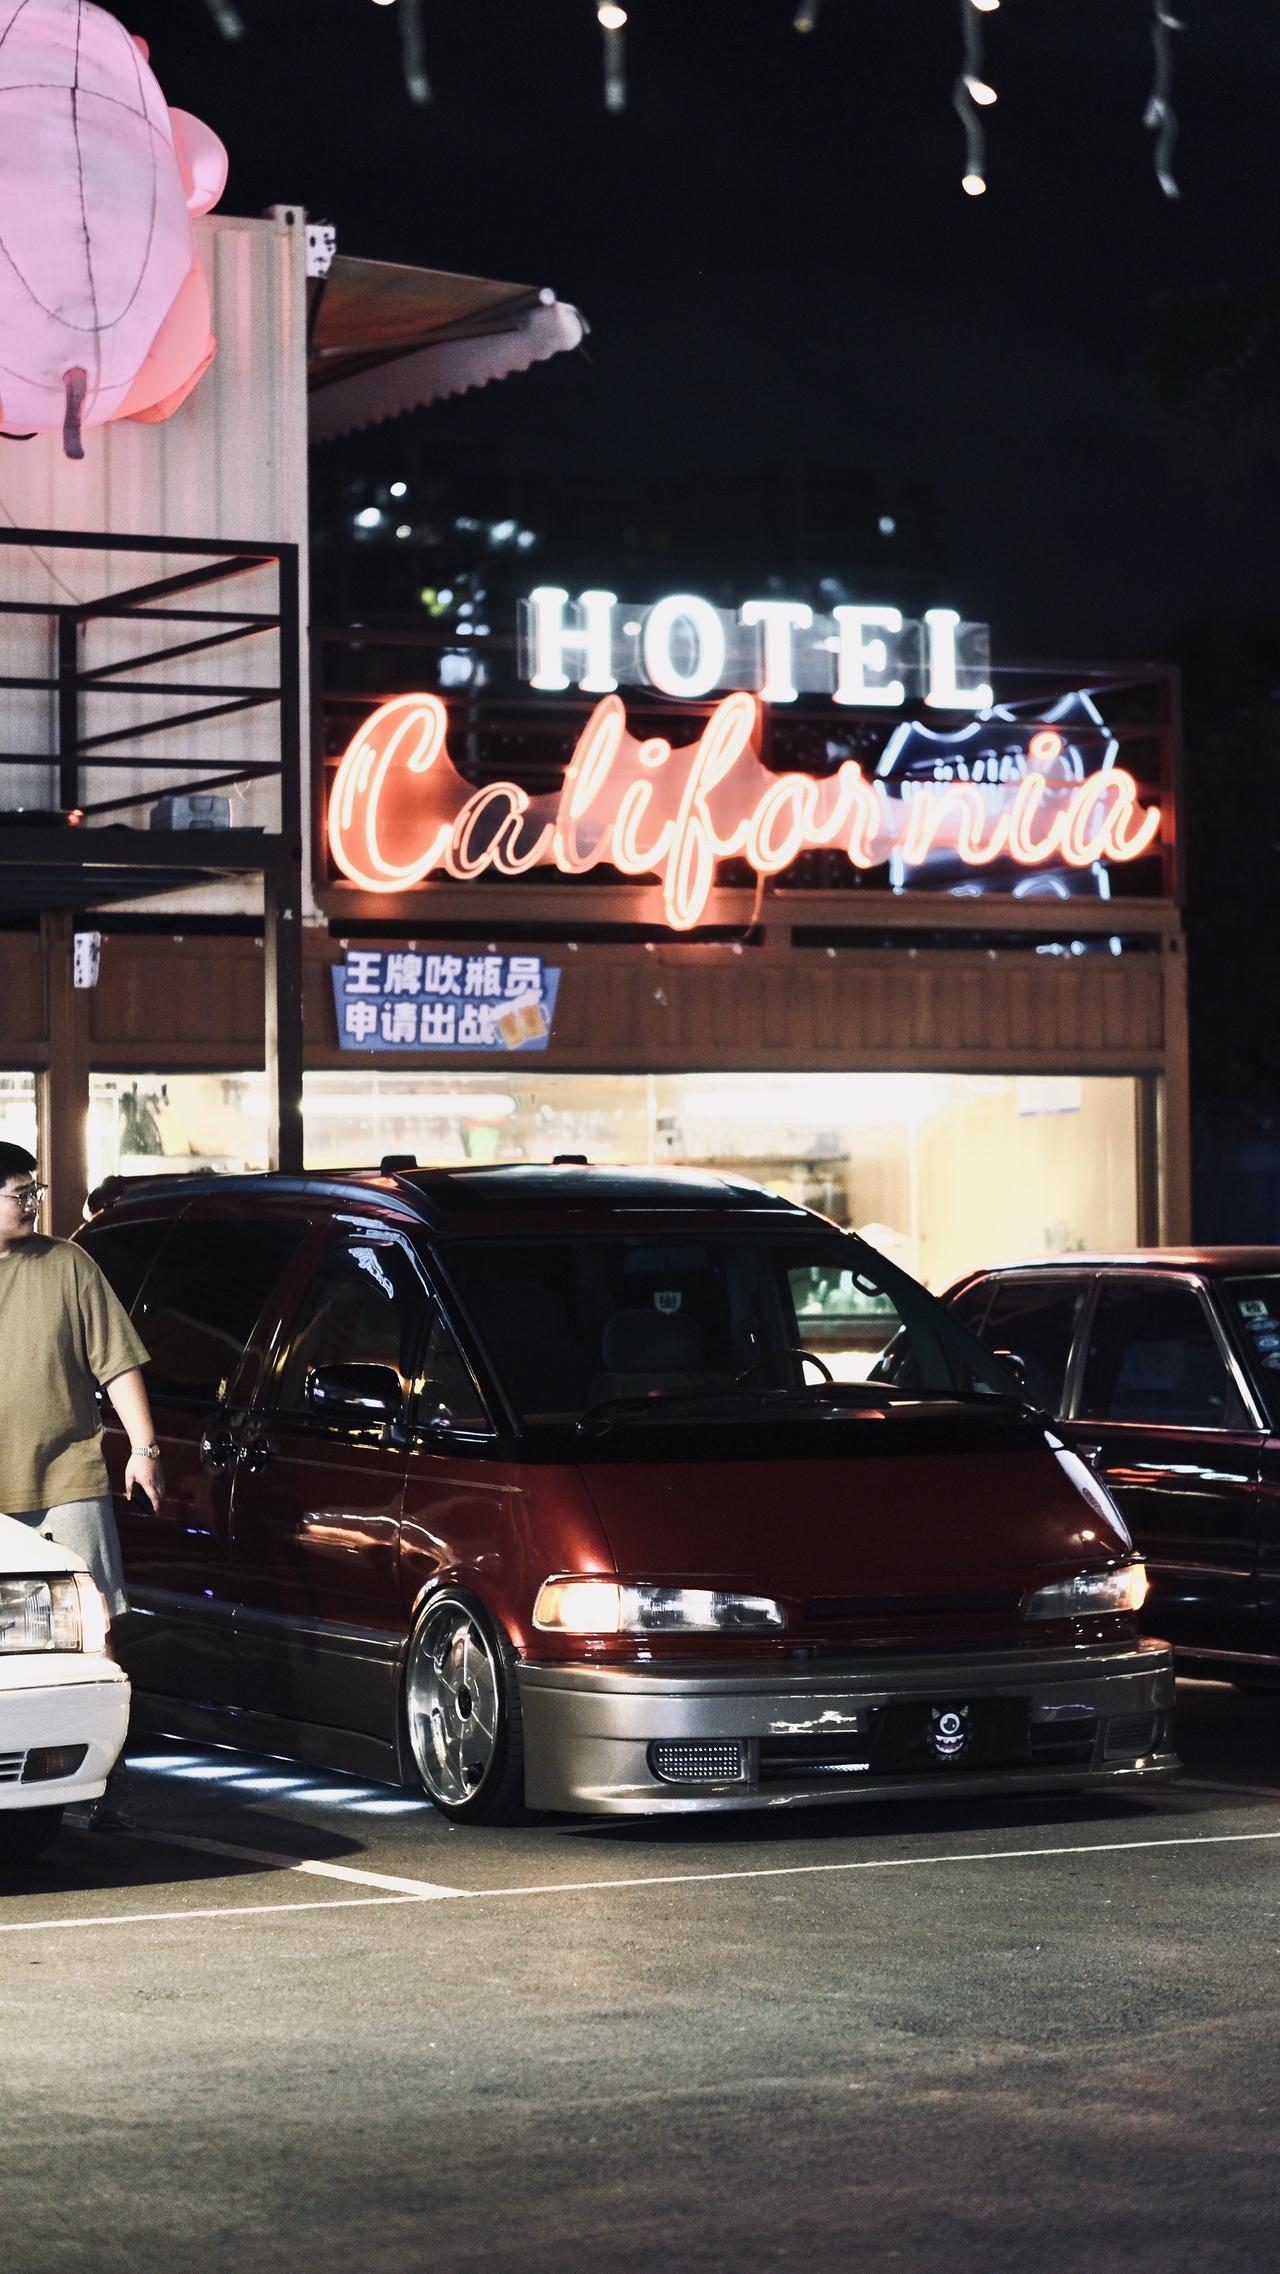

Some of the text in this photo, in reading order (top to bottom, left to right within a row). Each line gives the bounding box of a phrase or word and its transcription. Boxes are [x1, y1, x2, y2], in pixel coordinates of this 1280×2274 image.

[528, 585, 995, 711] HOTEL
[327, 691, 1162, 932] California
[345, 951, 543, 998] 王牌吹瓶员
[345, 1001, 498, 1045] 申请出战
